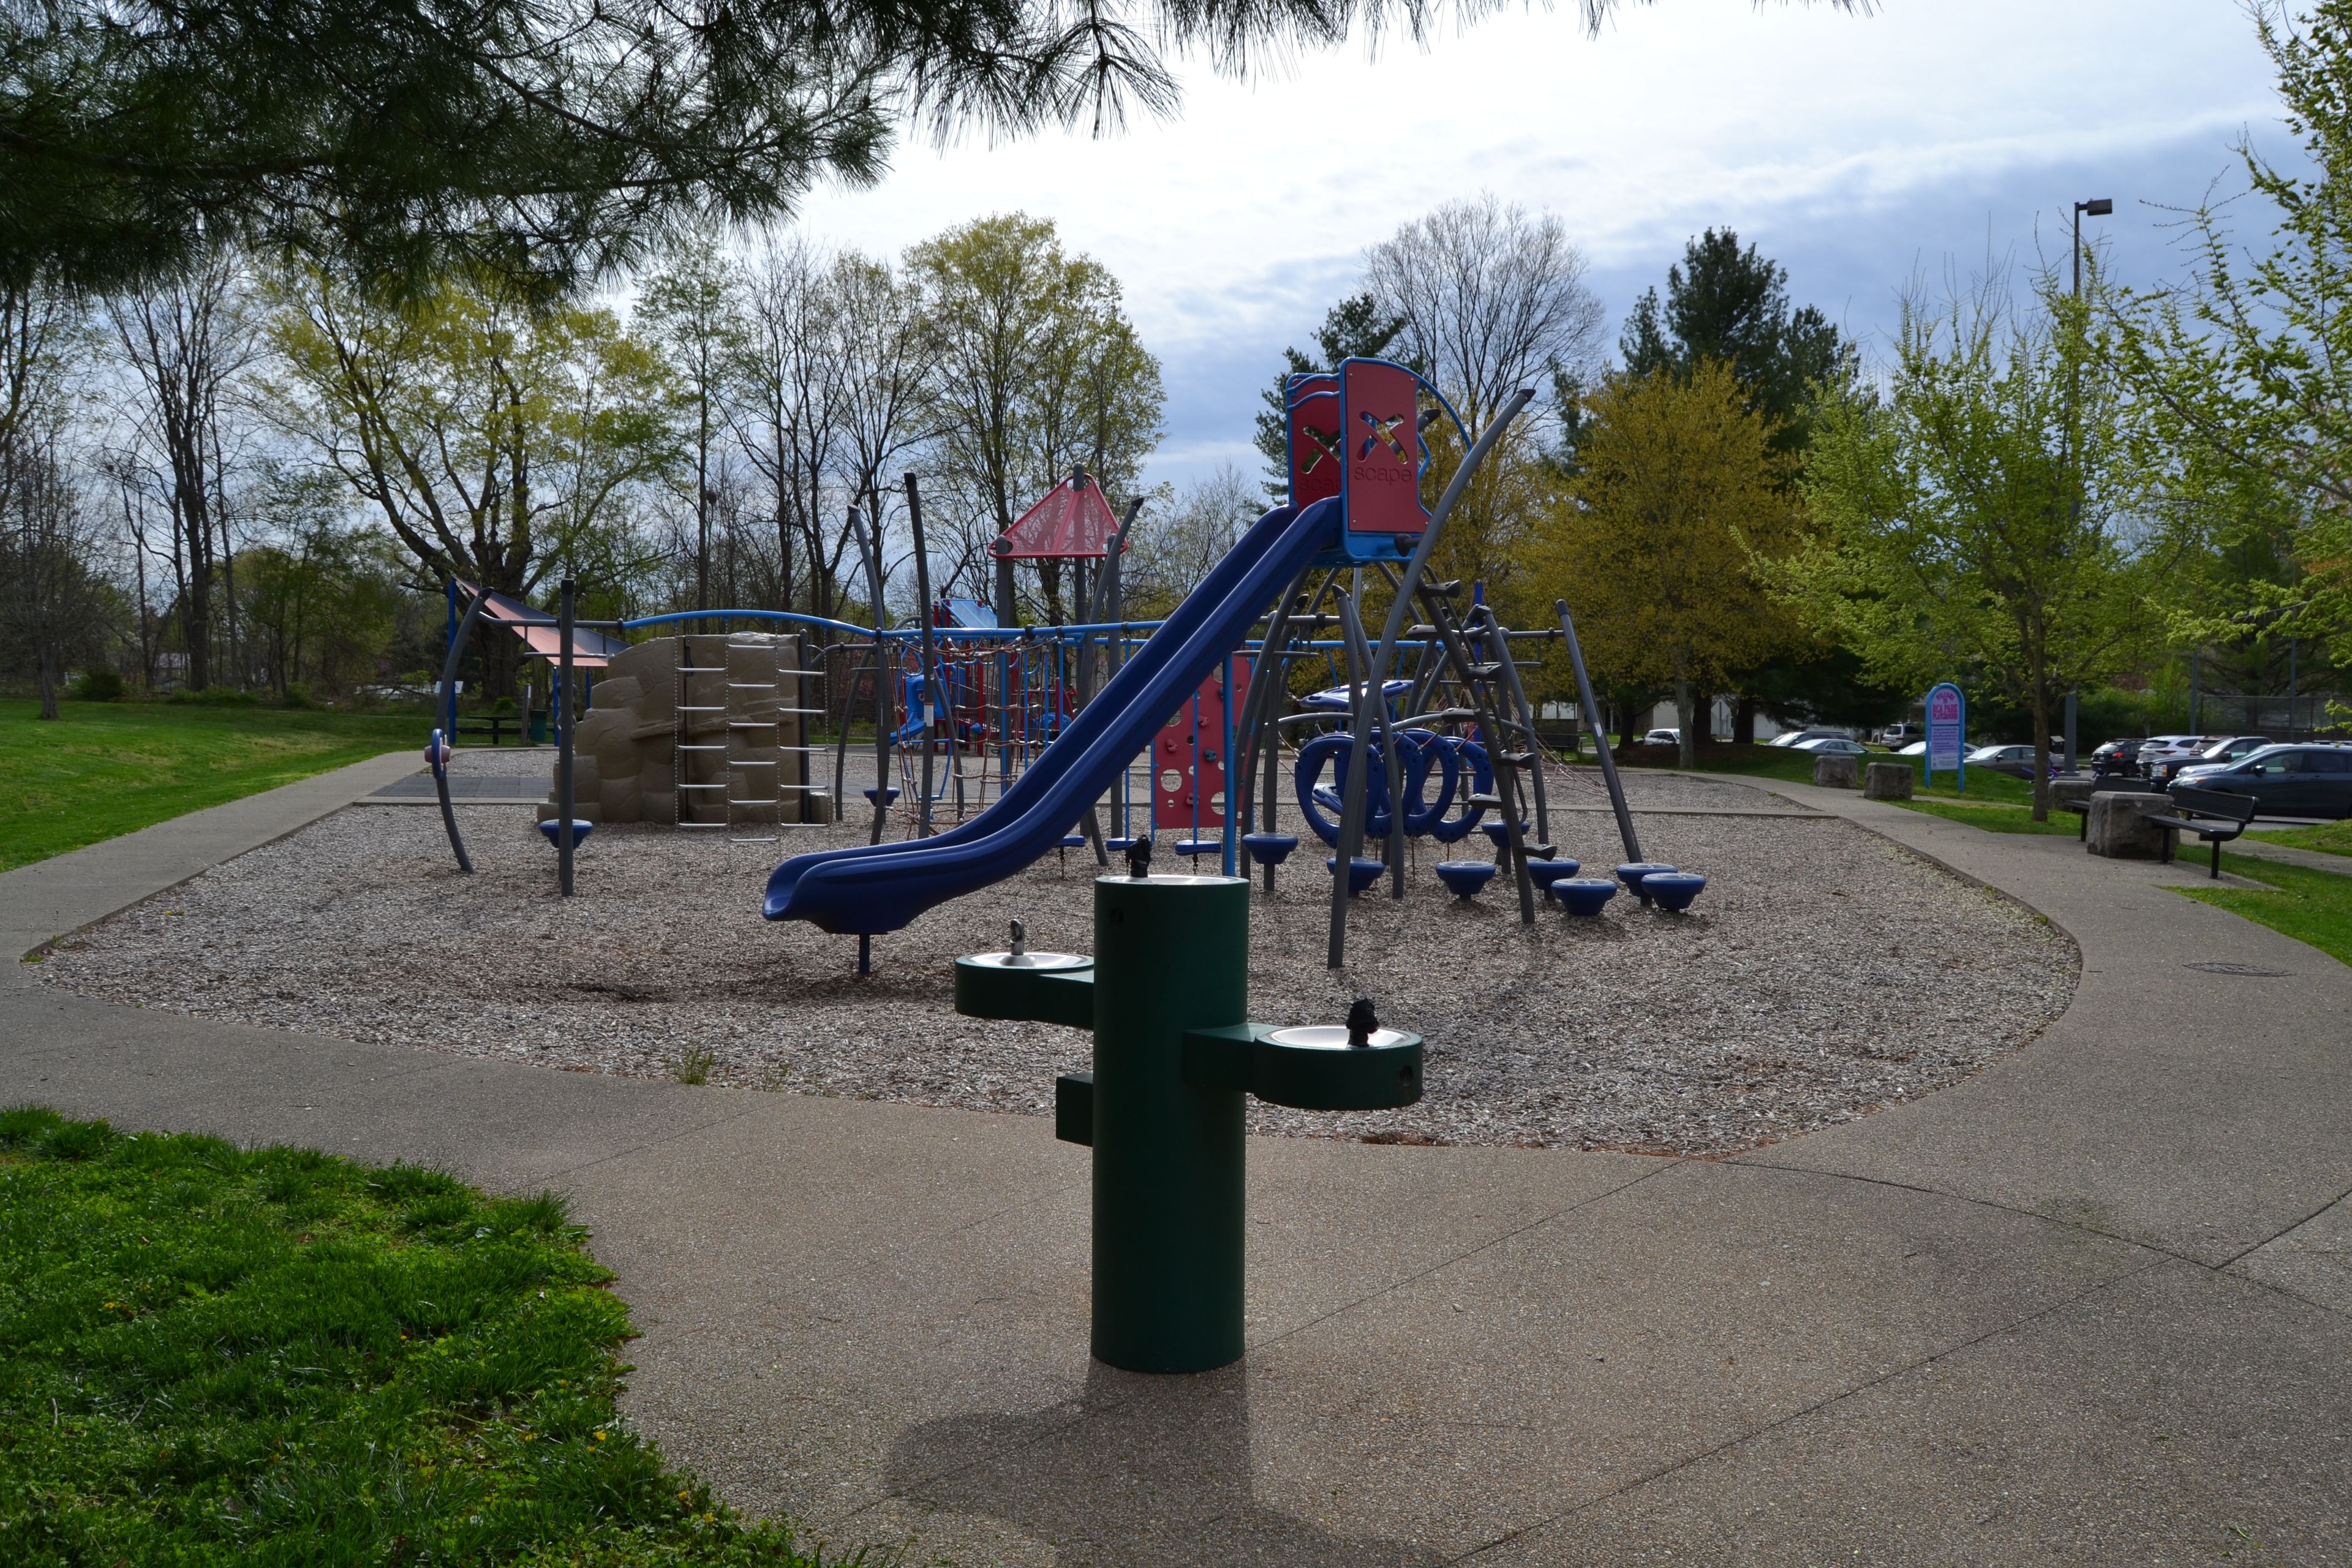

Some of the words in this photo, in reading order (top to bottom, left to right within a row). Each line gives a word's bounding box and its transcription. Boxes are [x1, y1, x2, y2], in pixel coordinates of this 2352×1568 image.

[1354, 467, 1412, 486] scape
[1936, 692, 1956, 701] WELCOME
[1944, 704, 1958, 713] PARK
